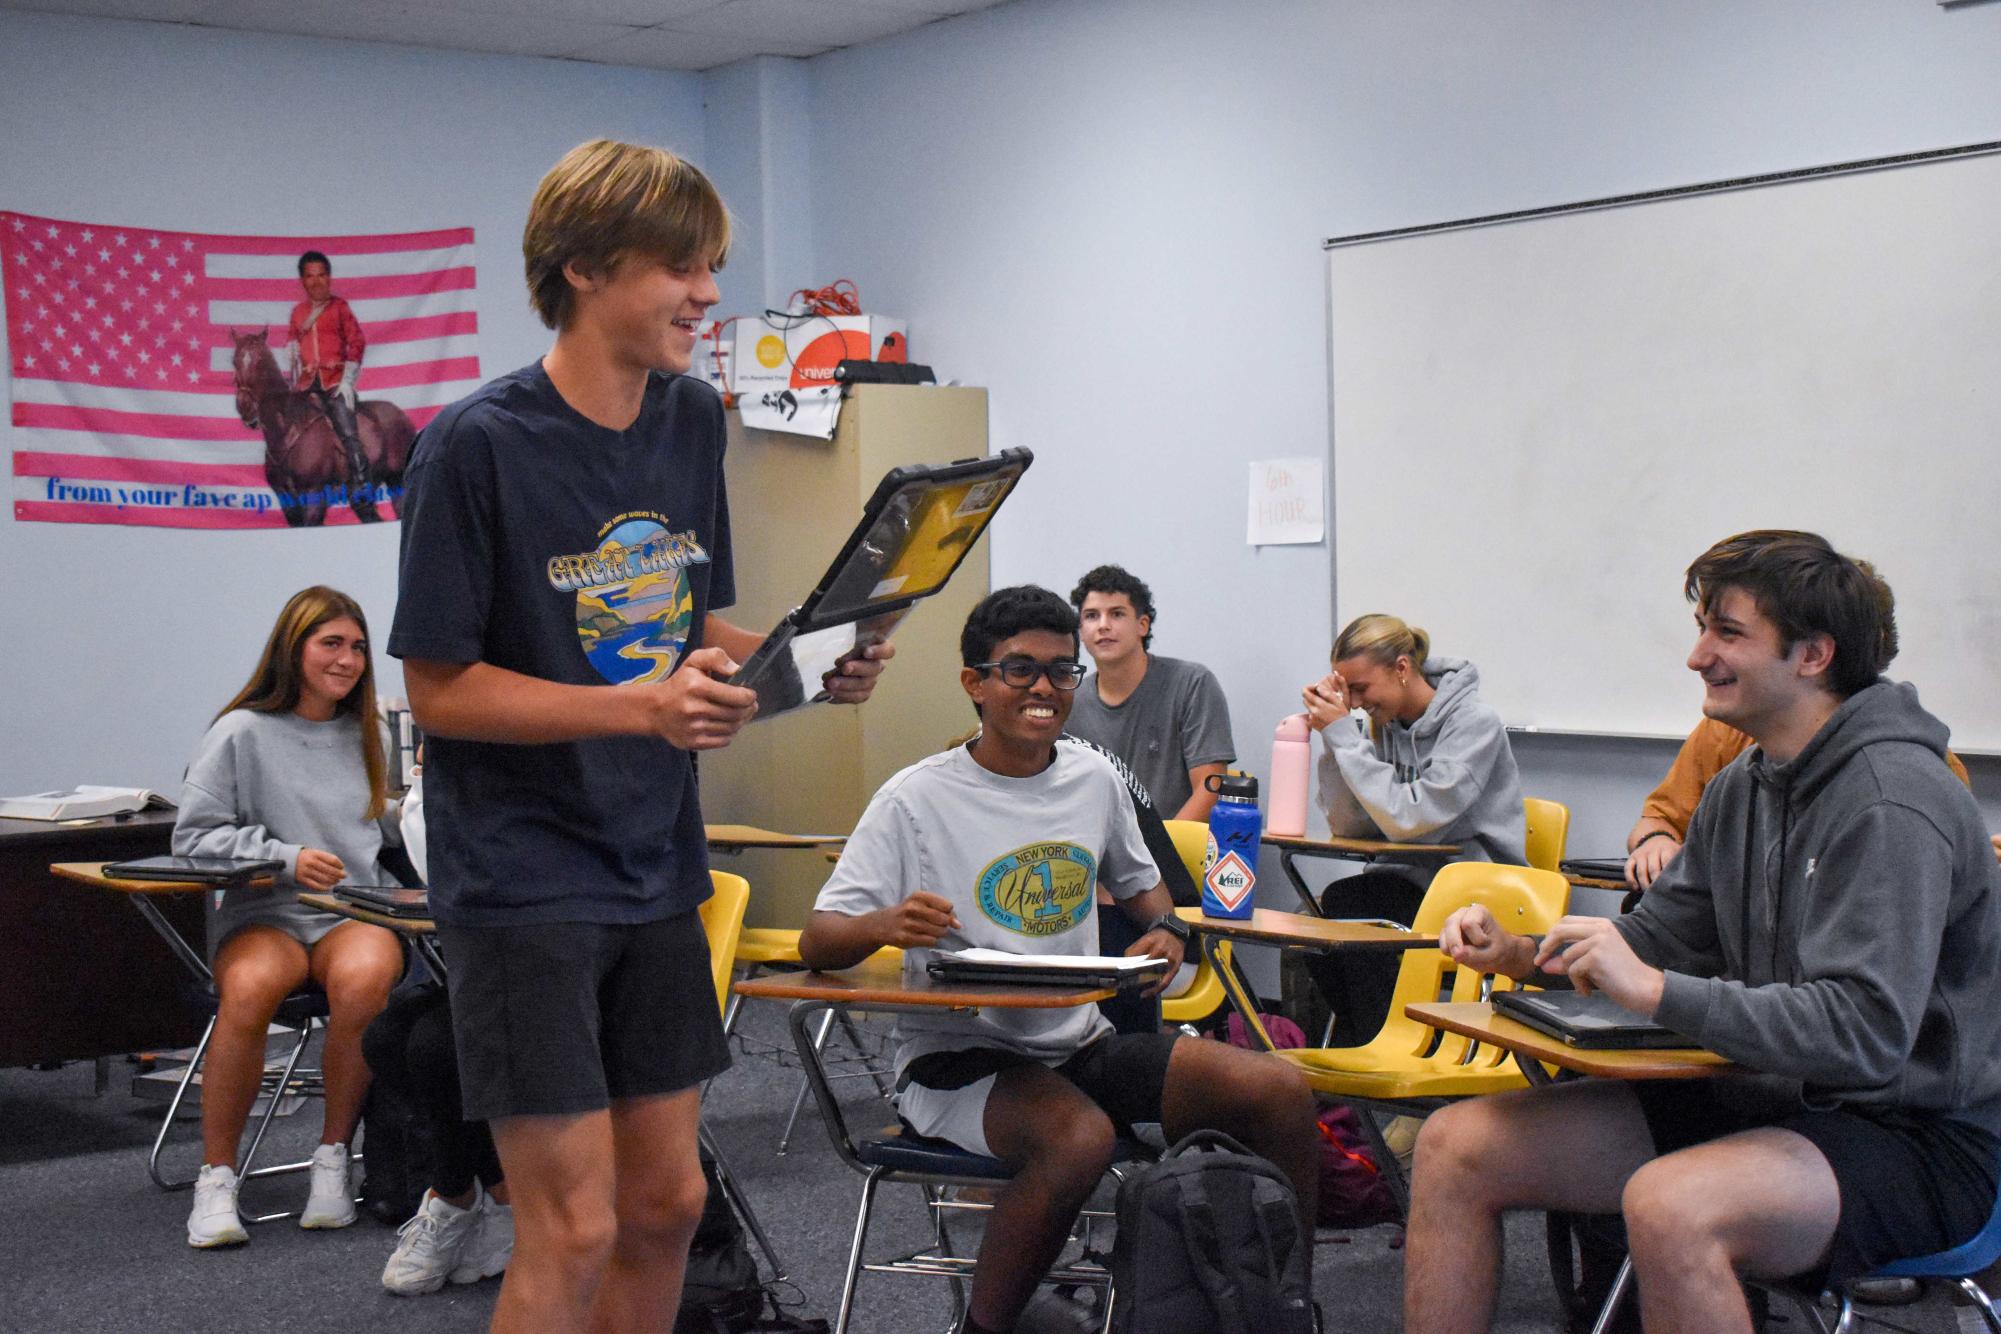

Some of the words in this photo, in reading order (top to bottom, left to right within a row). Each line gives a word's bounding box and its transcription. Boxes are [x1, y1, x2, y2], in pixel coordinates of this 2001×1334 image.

[47, 476, 111, 502] from
[117, 487, 177, 511] your
[183, 484, 237, 507] fave
[242, 493, 272, 515] ap
[628, 510, 650, 518] waves
[1016, 848, 1039, 865] NEW
[1041, 846, 1068, 858] YORK
[1227, 877, 1243, 885] REI
[986, 901, 1013, 924] REPAIR
